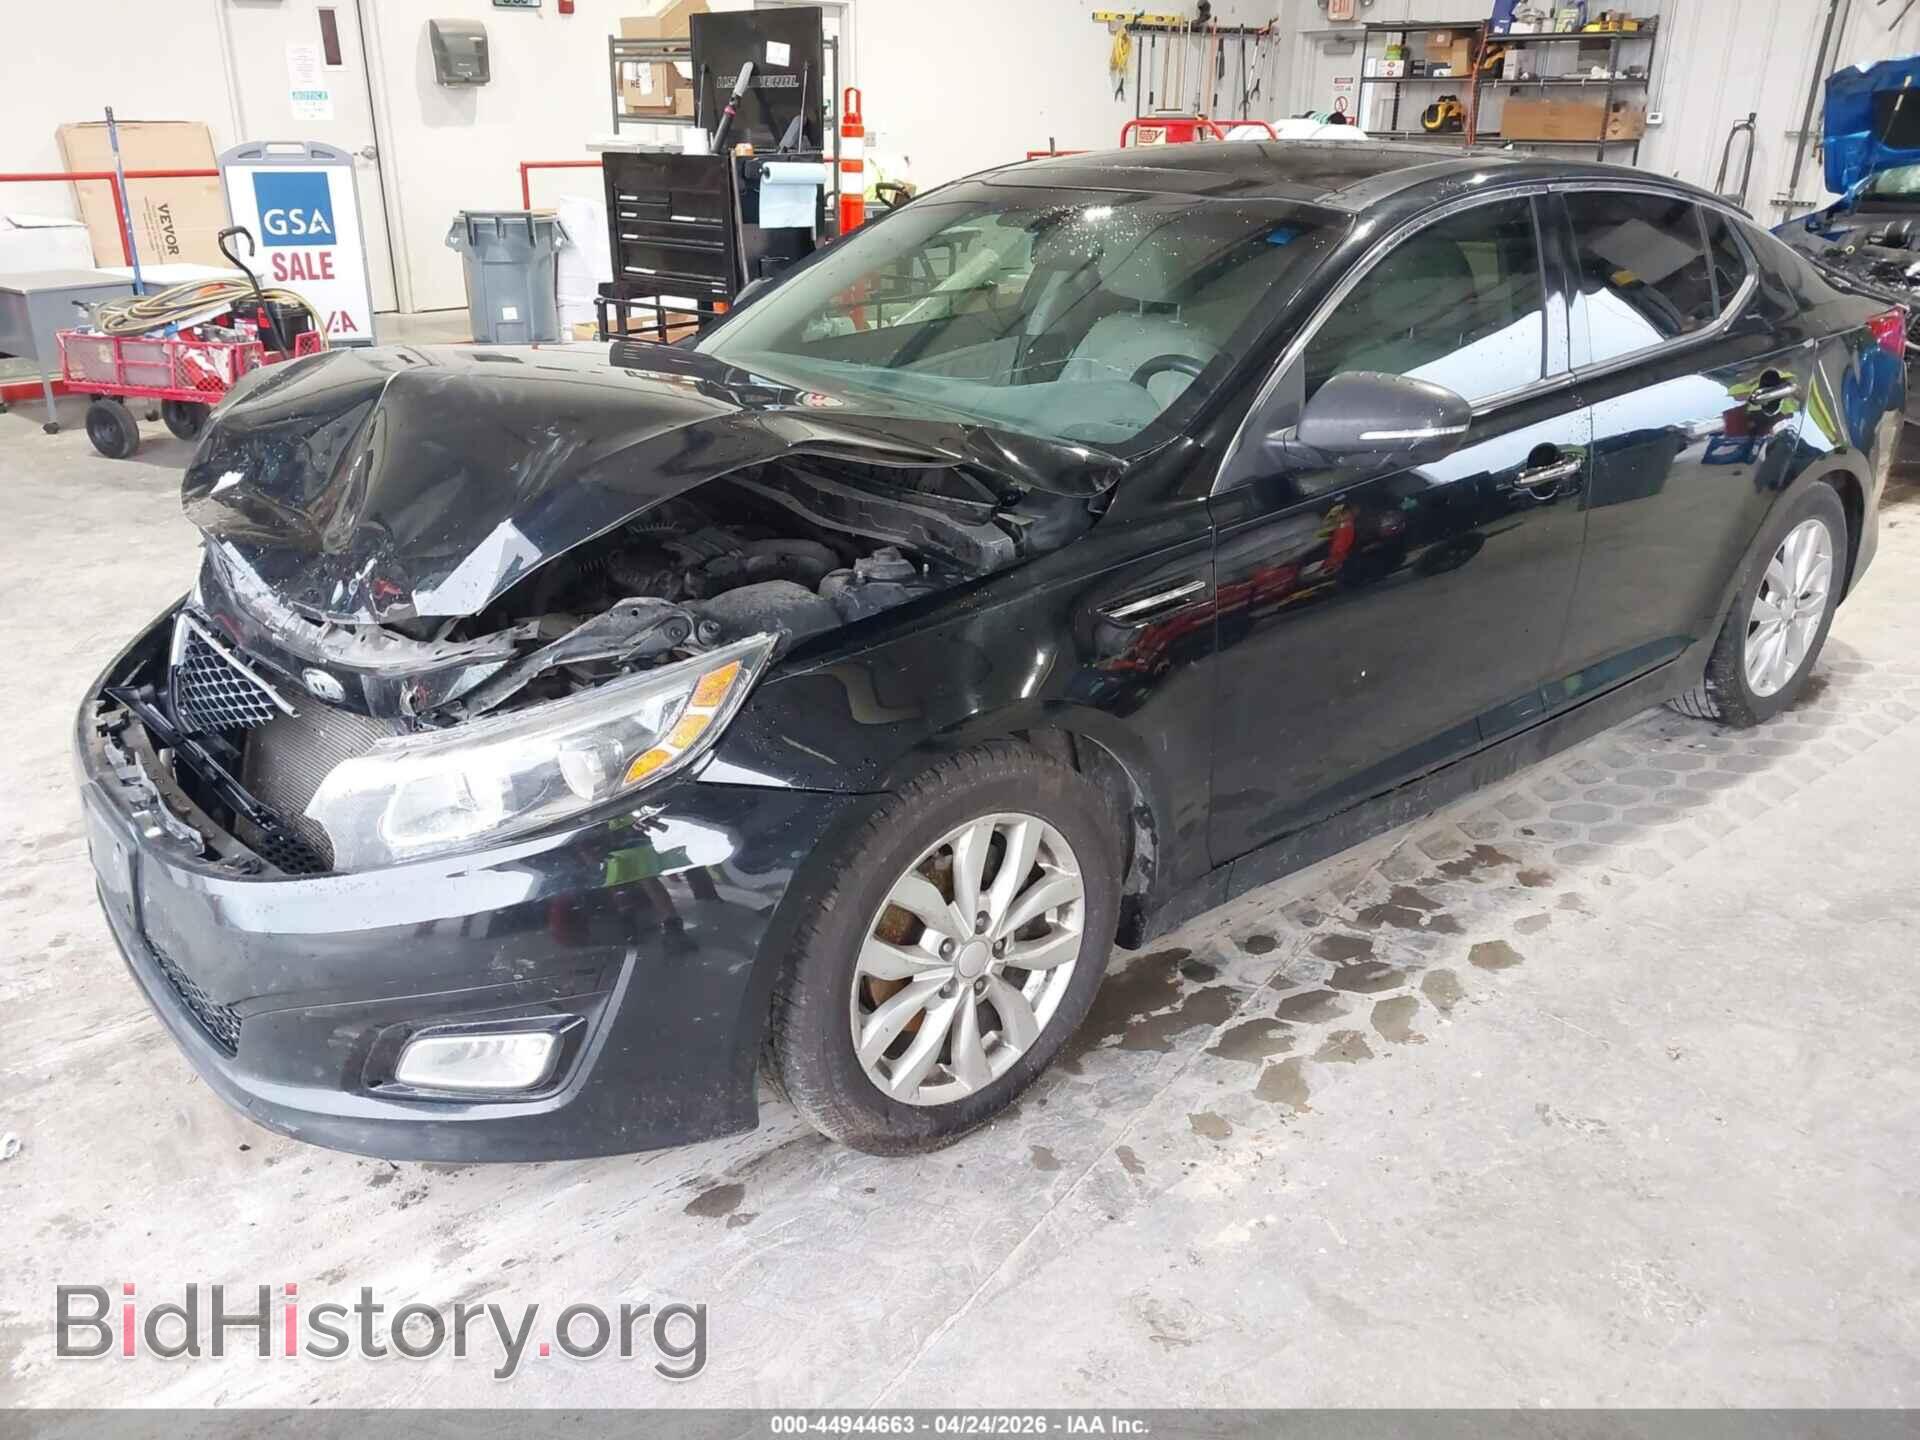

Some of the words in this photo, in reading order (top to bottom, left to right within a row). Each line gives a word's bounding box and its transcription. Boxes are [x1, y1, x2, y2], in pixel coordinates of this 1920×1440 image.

[157, 203, 180, 256] VEVOR
[263, 208, 332, 236] GSA
[271, 251, 336, 282] SALE
